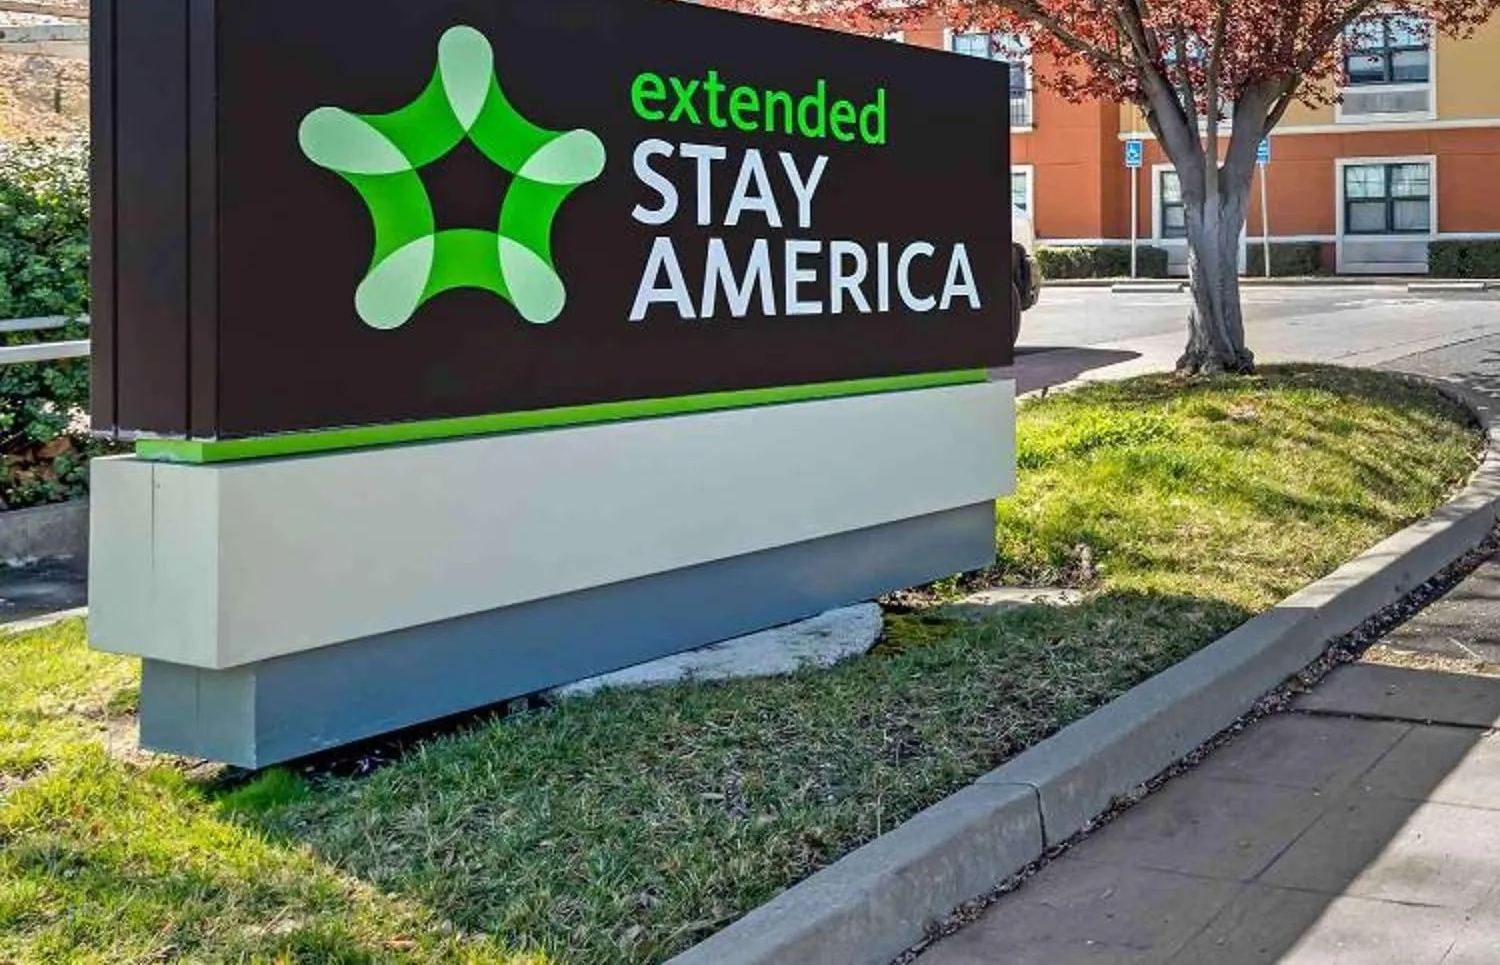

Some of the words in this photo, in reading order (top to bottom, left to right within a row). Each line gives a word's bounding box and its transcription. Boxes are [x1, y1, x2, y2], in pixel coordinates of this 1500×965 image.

[631, 70, 886, 145] extended
[631, 138, 829, 228] STAY
[628, 236, 981, 321] AMERICA
